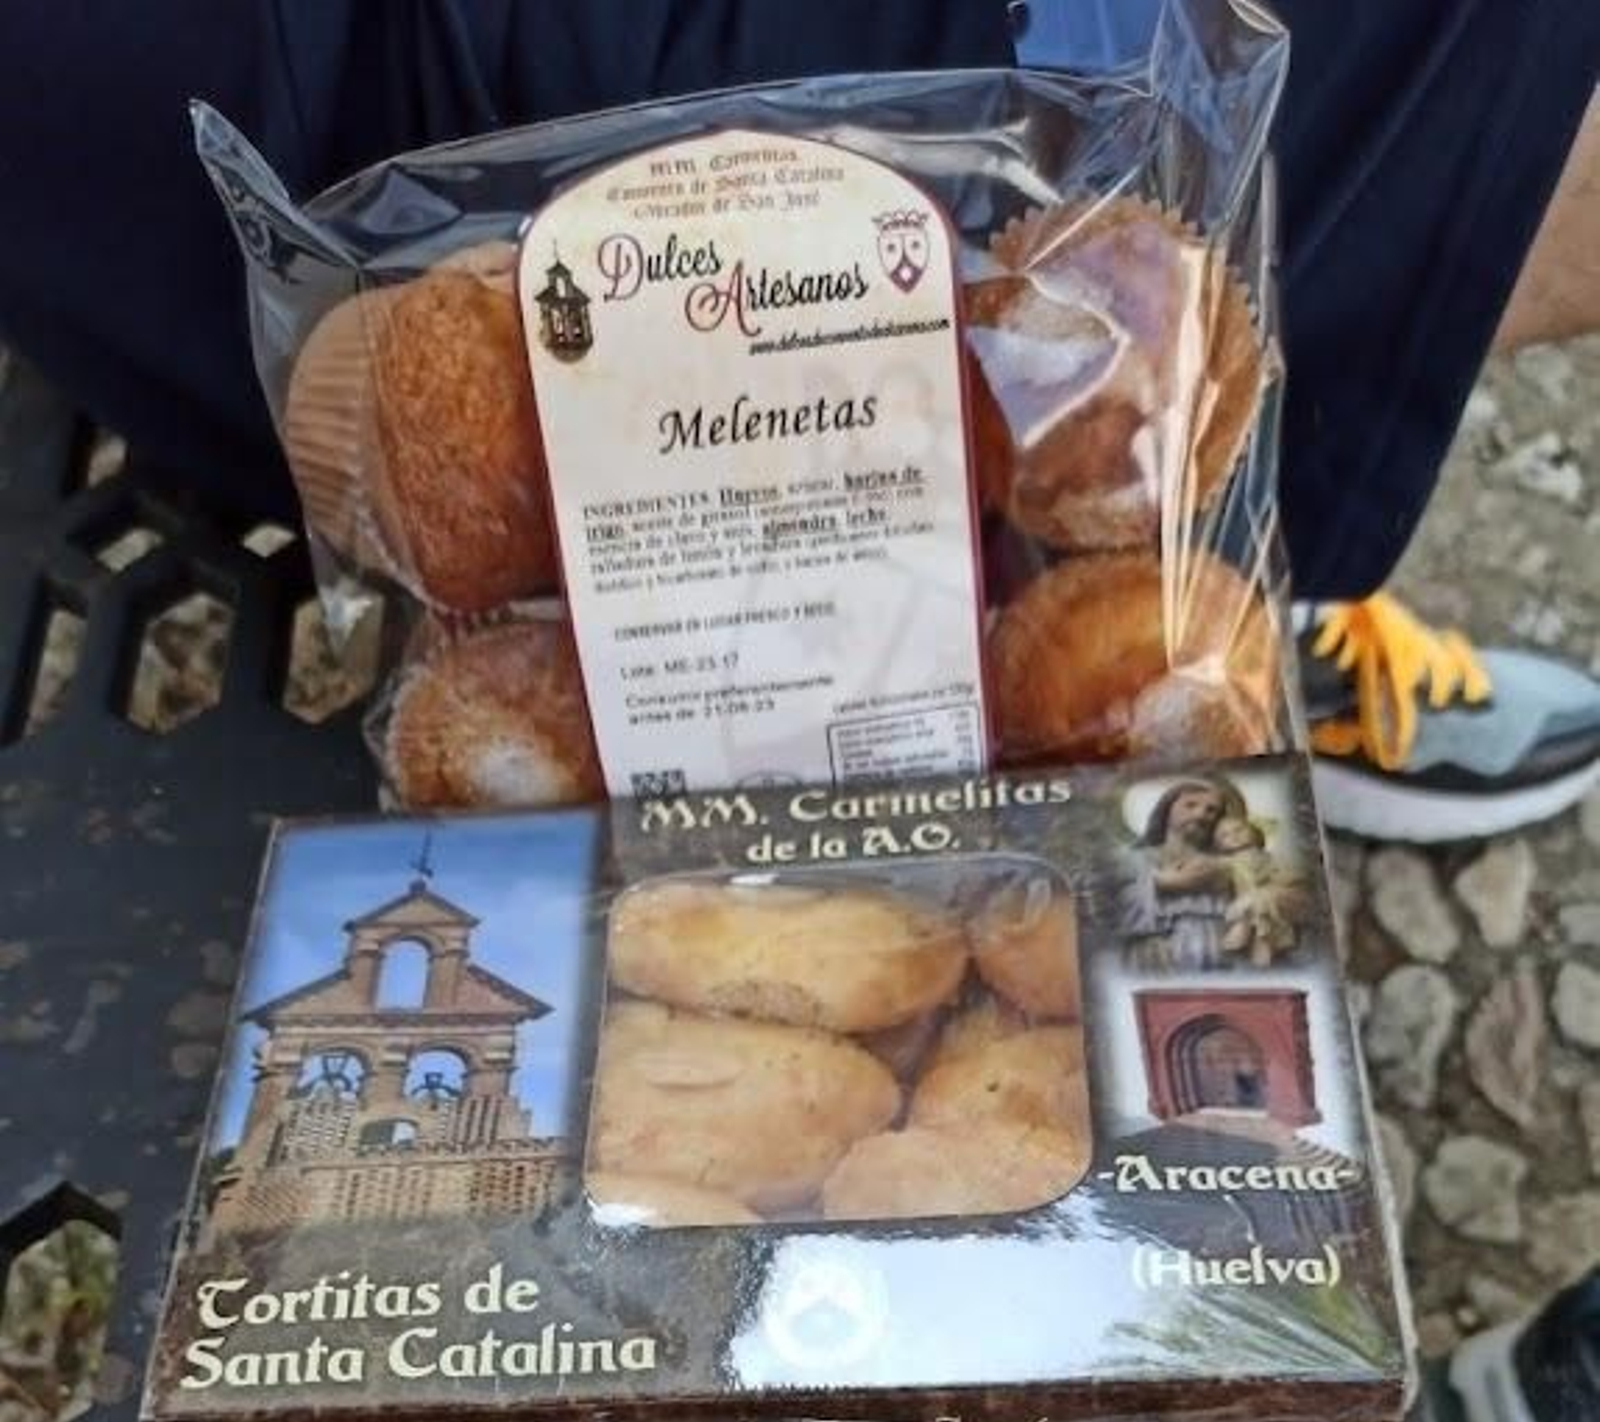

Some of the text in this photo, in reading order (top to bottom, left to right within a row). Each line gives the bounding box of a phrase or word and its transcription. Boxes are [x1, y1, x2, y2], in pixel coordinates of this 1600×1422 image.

[597, 232, 722, 302] Dulces
[684, 257, 869, 337] Artesanos
[659, 394, 878, 455] Melenetas
[641, 779, 1072, 832] MM. Carmelitas
[747, 822, 961, 863] de la A.O.
[197, 1263, 540, 1329] Tortitas de
[1132, 1243, 1342, 1290] (Huelva)
[180, 1322, 657, 1389] Santa Catalina
